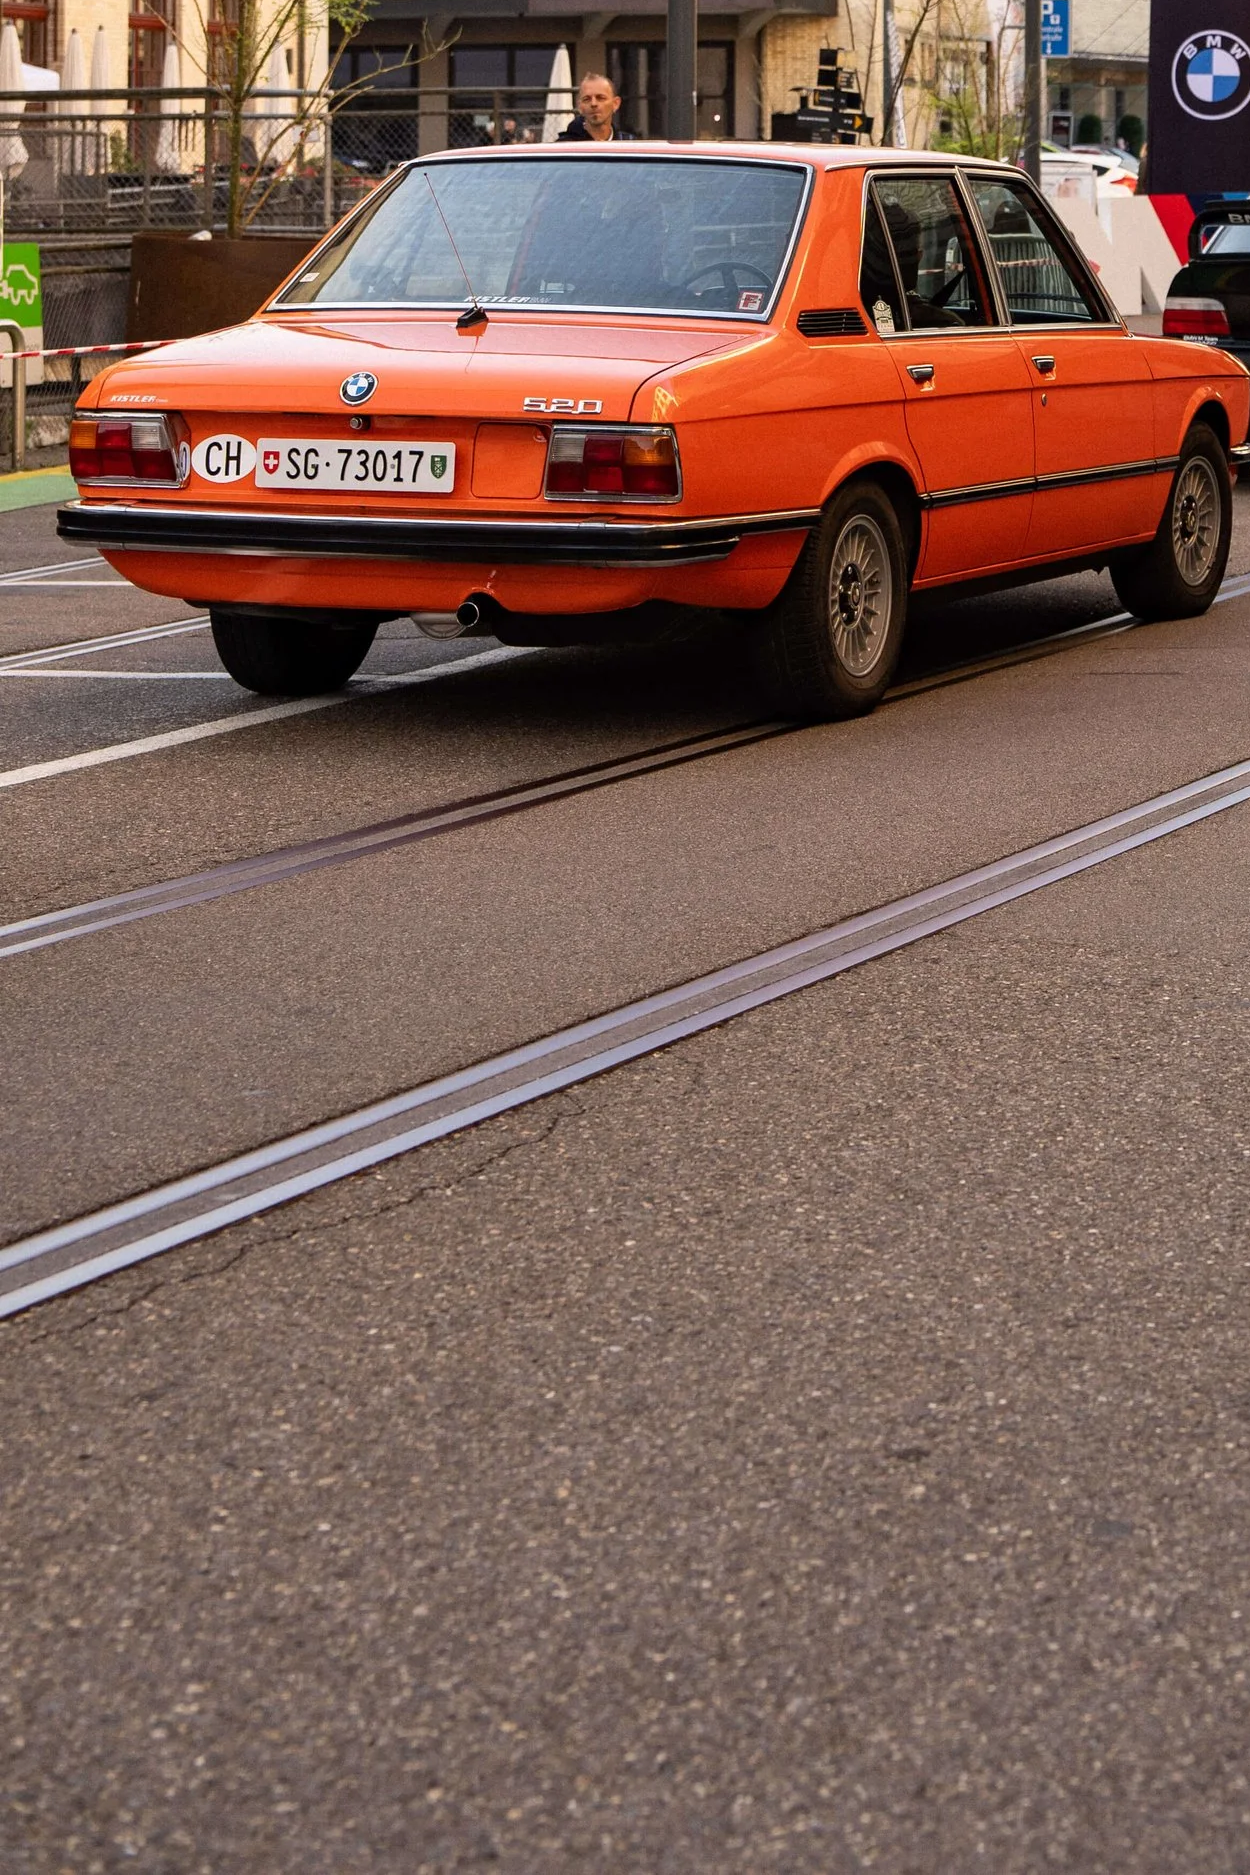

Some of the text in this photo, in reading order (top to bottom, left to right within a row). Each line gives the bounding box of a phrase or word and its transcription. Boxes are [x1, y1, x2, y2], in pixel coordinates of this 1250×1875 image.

[1182, 35, 1247, 60] BMW
[110, 395, 157, 403] KISTLER
[523, 397, 603, 414] 520
[204, 441, 242, 477] CH
